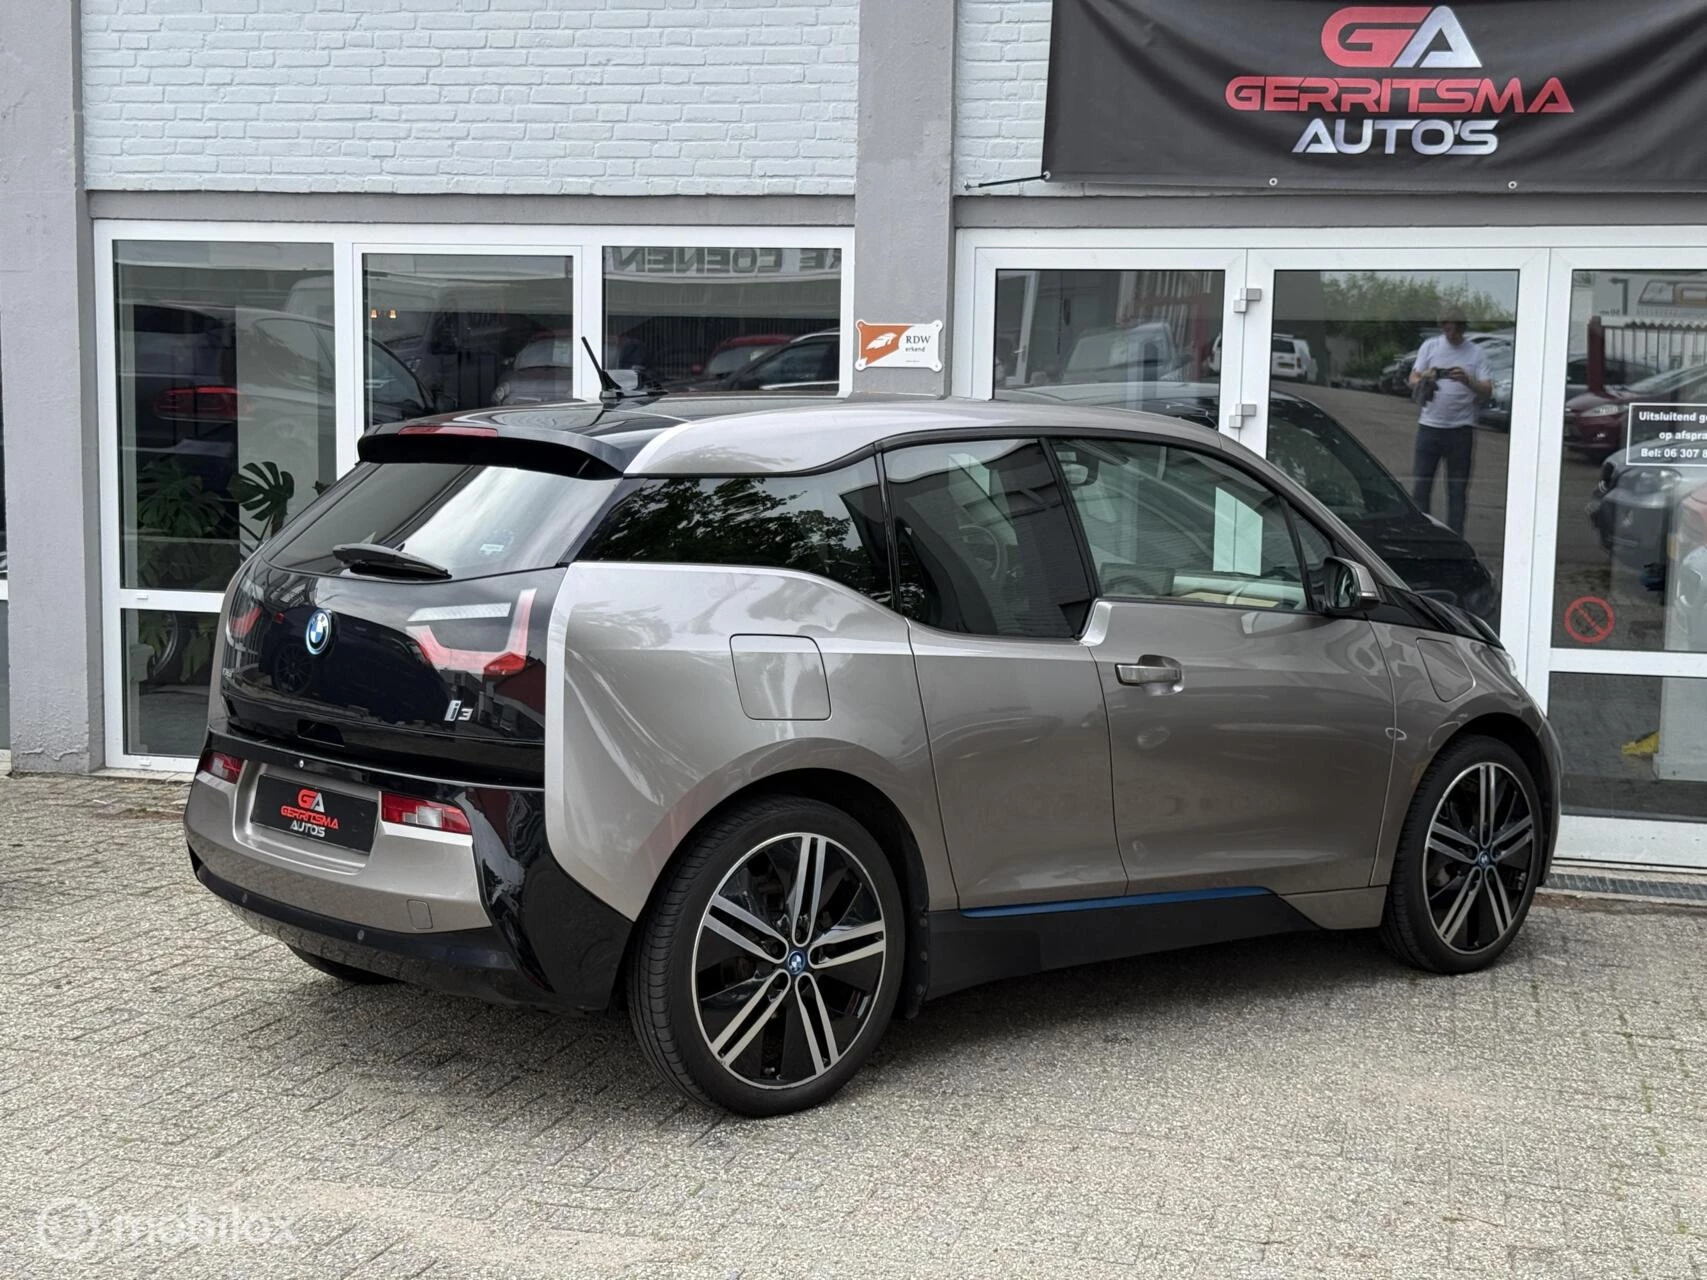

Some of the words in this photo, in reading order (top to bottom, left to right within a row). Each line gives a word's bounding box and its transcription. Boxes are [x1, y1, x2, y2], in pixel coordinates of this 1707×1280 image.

[1321, 5, 1483, 68] GA
[1225, 76, 1575, 113] GERRITSMA
[1291, 118, 1500, 155] AUTO'S
[905, 335, 931, 345] RDW
[1639, 411, 1697, 421] Uitsluitend
[1699, 414, 1707, 424] g
[1659, 432, 1673, 441] op
[1641, 448, 1661, 458] Bel:
[1663, 448, 1678, 458] 06
[1679, 448, 1700, 458] 307
[297, 789, 325, 813] GA
